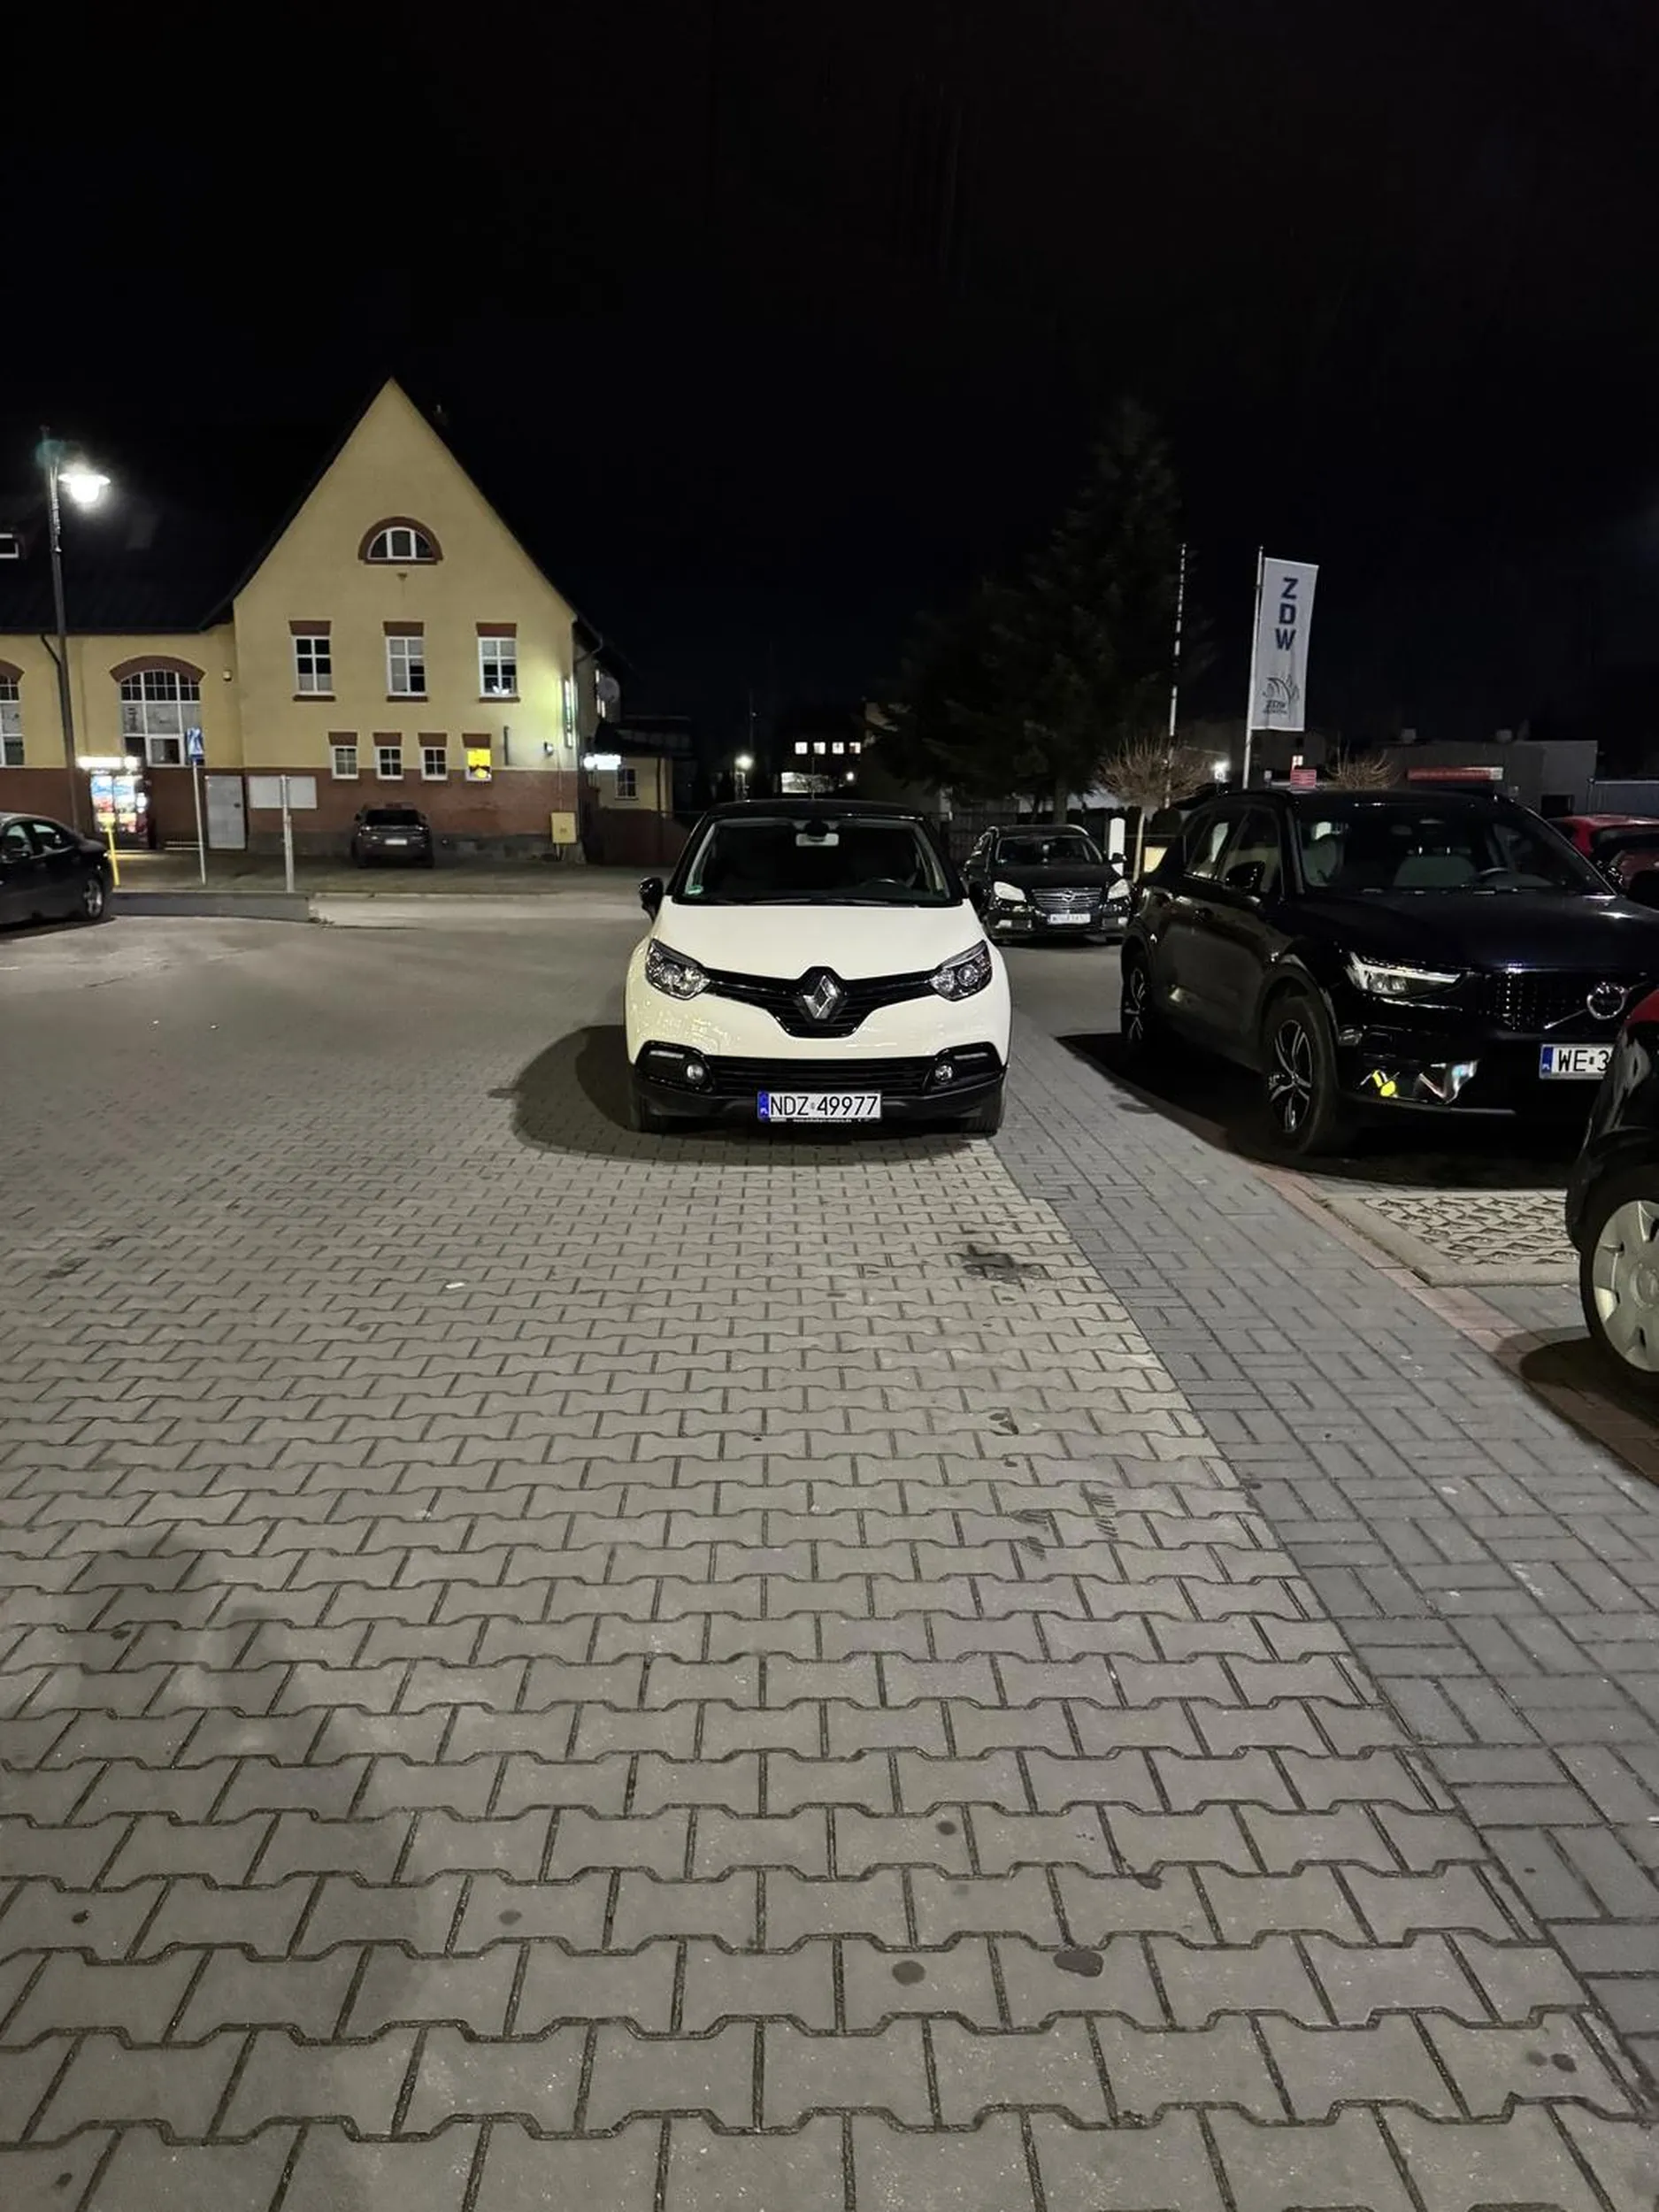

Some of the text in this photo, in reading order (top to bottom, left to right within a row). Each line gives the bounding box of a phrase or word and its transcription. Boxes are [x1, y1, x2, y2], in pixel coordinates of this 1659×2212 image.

[1275, 576, 1299, 651] ZDW
[1558, 1048, 1588, 1072] WE
[770, 1095, 879, 1116] NDZ 49977
